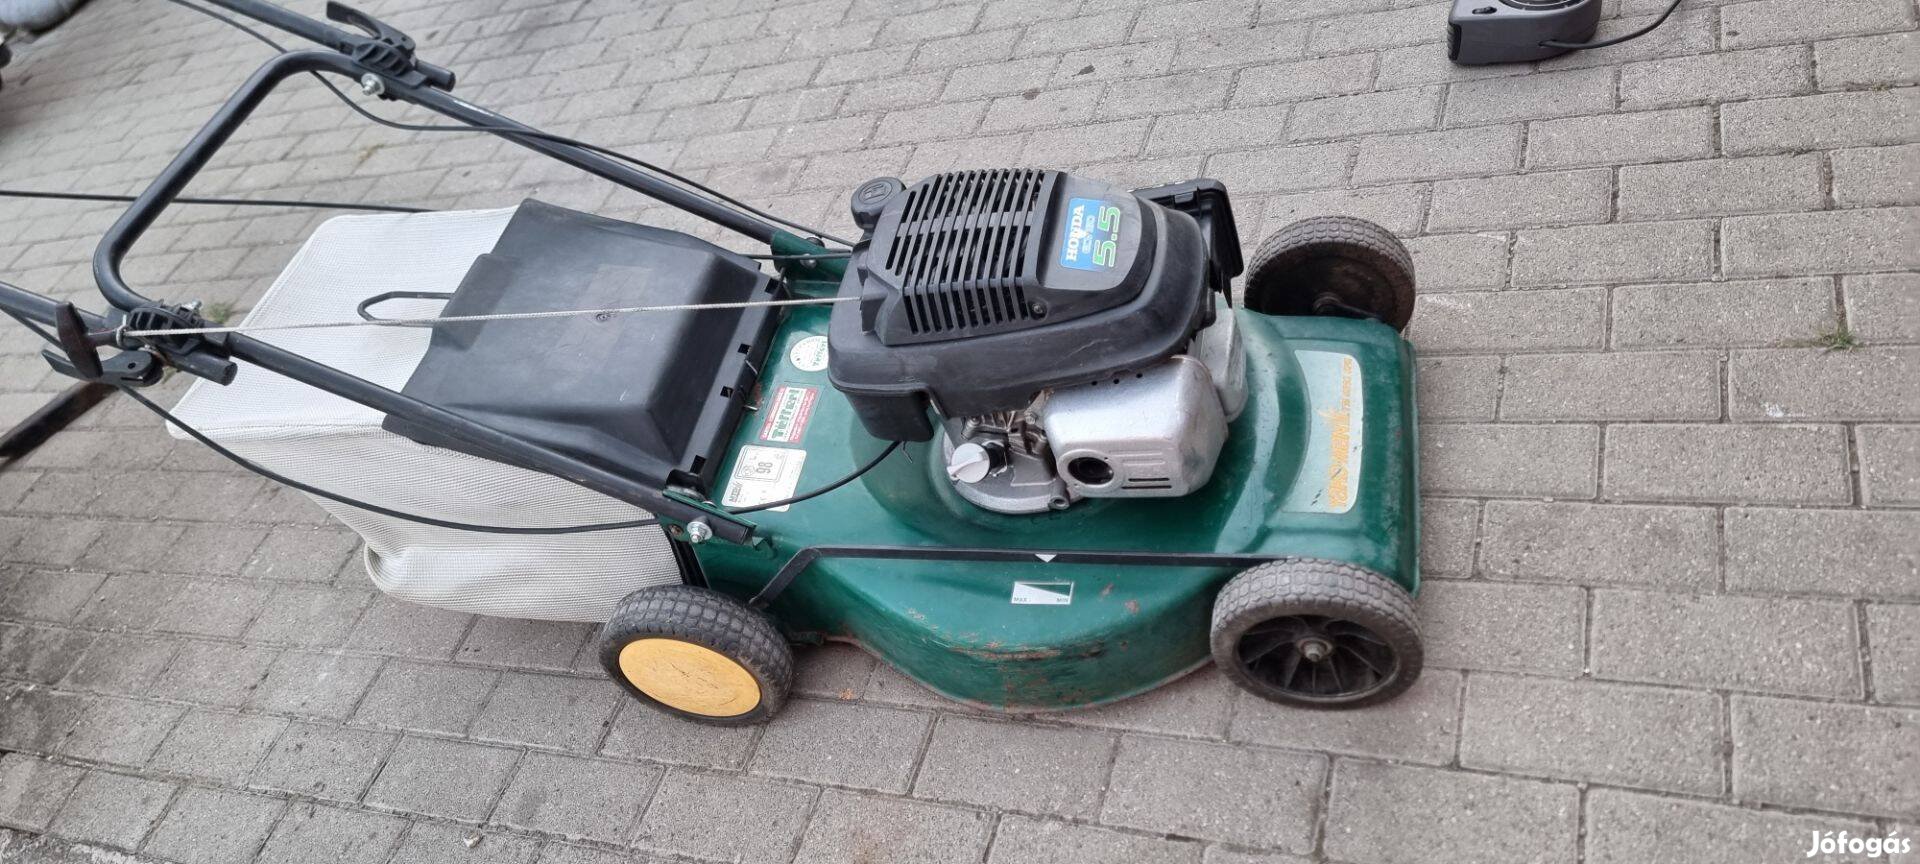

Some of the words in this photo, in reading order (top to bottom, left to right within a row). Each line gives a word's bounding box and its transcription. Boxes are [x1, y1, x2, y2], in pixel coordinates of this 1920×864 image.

[1066, 205, 1085, 262] HONDA
[1092, 206, 1121, 268] 5.5
[756, 461, 773, 475] 98
